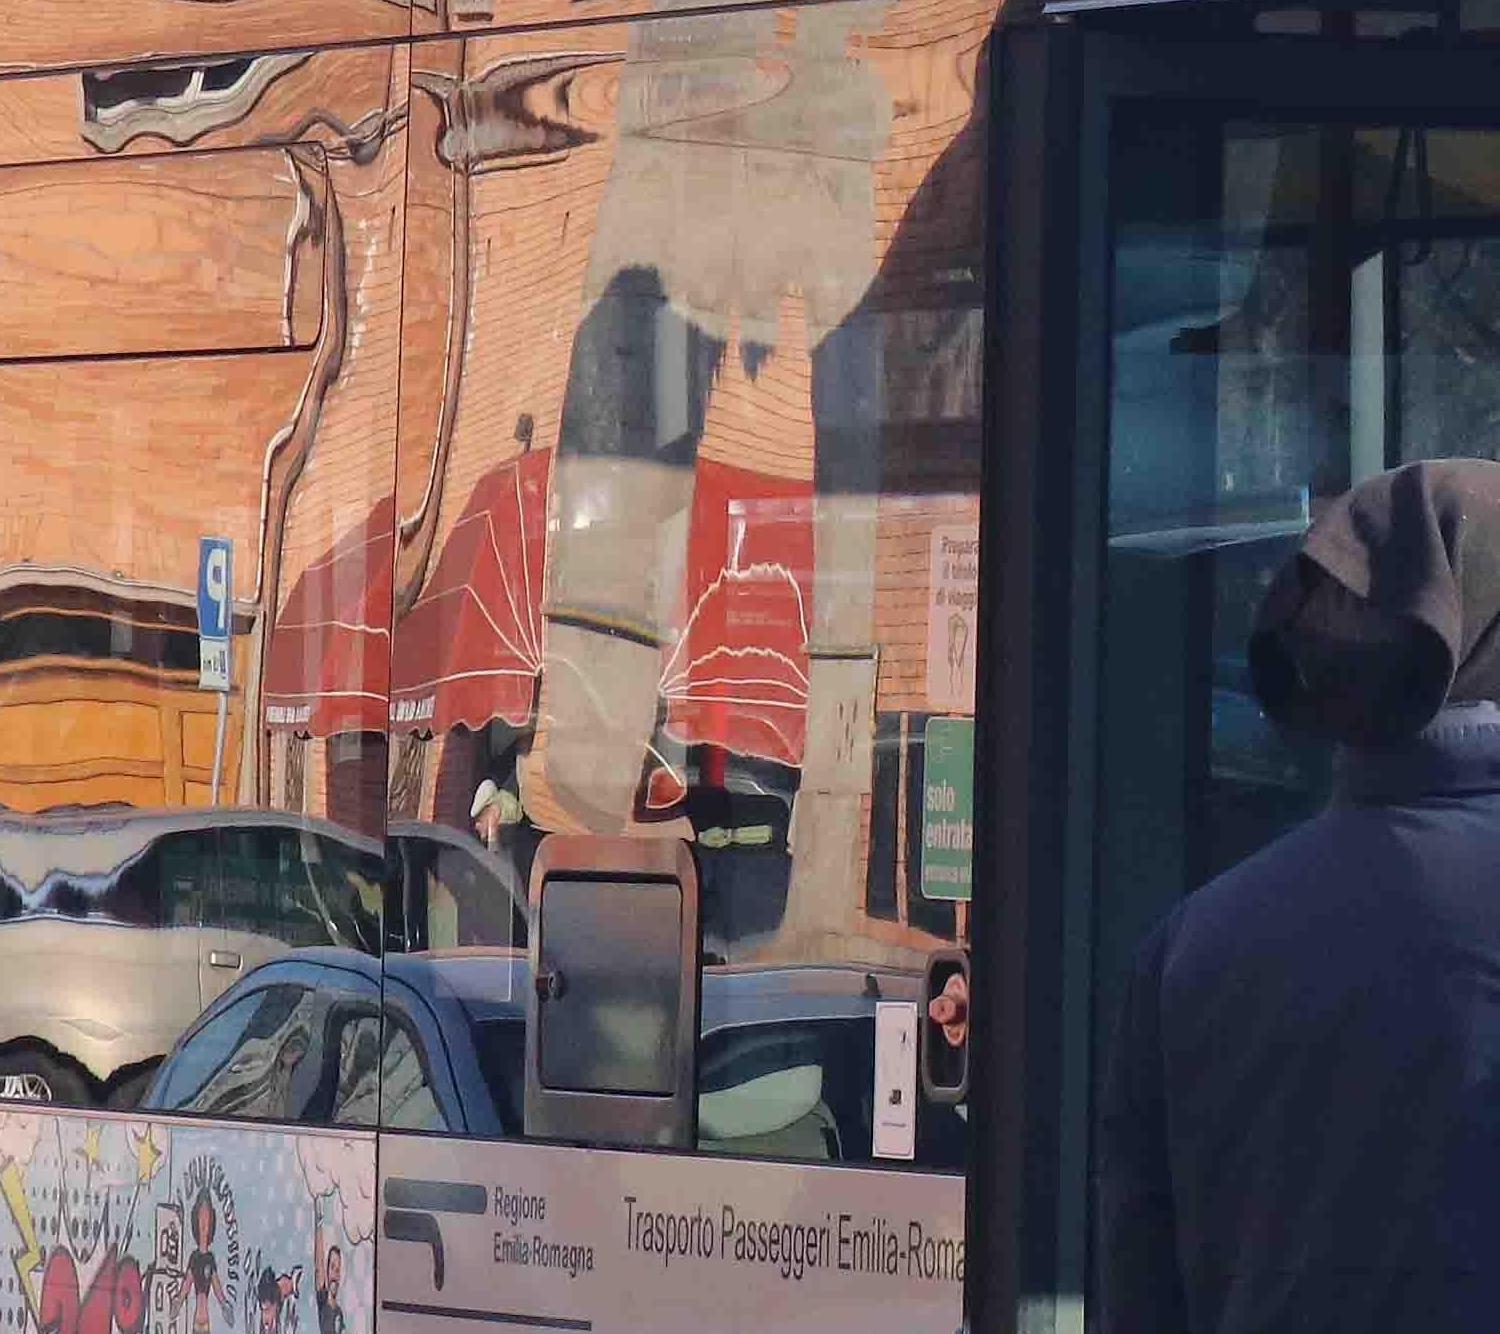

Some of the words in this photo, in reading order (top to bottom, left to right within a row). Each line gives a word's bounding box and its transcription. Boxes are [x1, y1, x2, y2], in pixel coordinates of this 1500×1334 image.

[494, 1187, 546, 1222] Regione
[494, 1231, 594, 1278] Emilia-Romagna
[624, 1197, 715, 1272] Trasporto
[721, 1204, 832, 1281] Passeggeri
